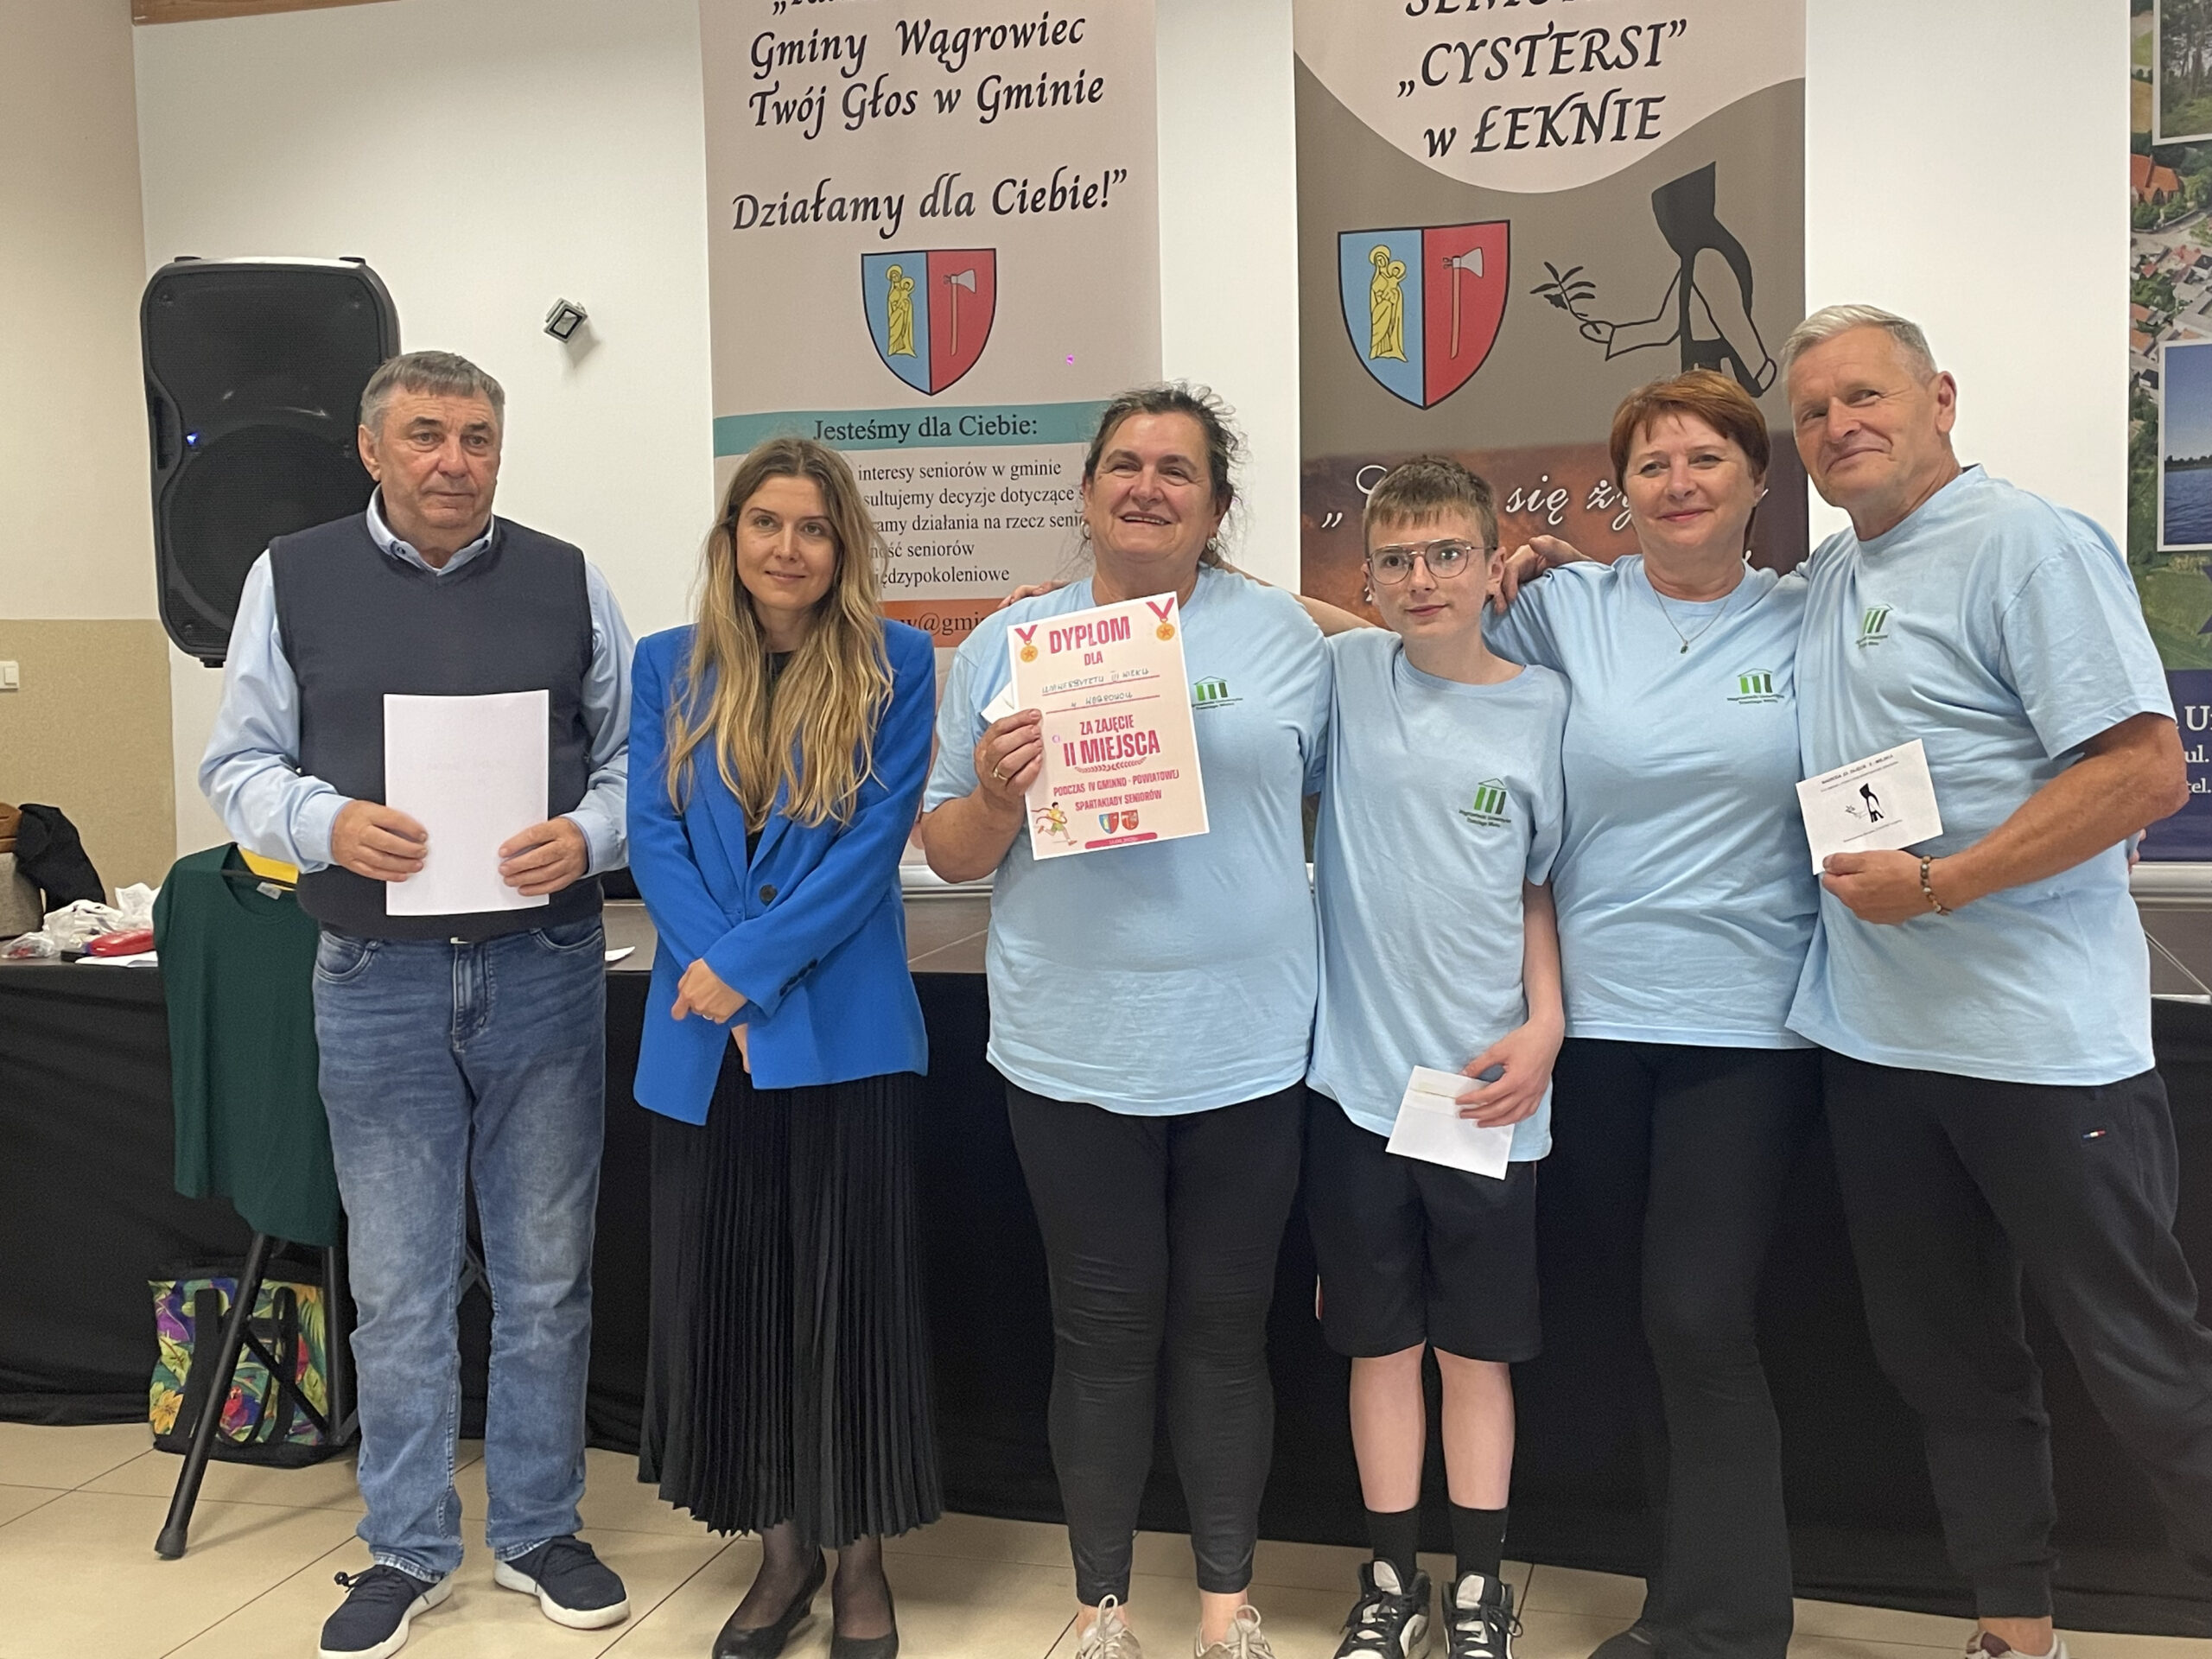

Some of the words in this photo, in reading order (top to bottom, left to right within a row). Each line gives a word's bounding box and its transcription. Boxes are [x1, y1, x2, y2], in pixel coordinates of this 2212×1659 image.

[751, 29, 868, 79] Gminy
[896, 11, 1085, 73] Wągrowiec
[749, 80, 825, 140] Twój
[842, 73, 918, 130] Głos
[933, 87, 961, 113] w
[977, 69, 1104, 124] Gminie
[1424, 126, 1457, 157] w
[1471, 88, 1666, 154] ŁEKNIE
[733, 178, 905, 239] Działamy
[918, 173, 976, 218] dla
[992, 166, 1127, 215] Ciebie!”
[813, 420, 911, 443] Jesteśmy
[918, 416, 950, 436] dla
[959, 414, 1037, 436] Ciebie:
[858, 465, 914, 483] interesy
[919, 461, 988, 479] seniorów
[991, 465, 1005, 476] w
[1010, 458, 1061, 480] gminie
[864, 490, 934, 510] sultujemy
[939, 486, 995, 507] decyzje
[1001, 486, 1074, 506] dotyczące
[1505, 475, 1569, 525] się
[912, 514, 979, 531] działania
[984, 518, 1001, 529] na
[1006, 517, 1045, 529] rzecz
[907, 540, 975, 558] seniorów
[874, 566, 1009, 588] iędzypokoleniowe
[1049, 616, 1131, 654] DYPLOM
[1084, 651, 1103, 666] DLA
[1080, 721, 1093, 735] ZA
[1095, 715, 1134, 733] ZAJĘCIE
[1063, 742, 1077, 766] II
[1080, 730, 1160, 764] MIEJSCA
[2184, 744, 2209, 763] ul.
[1053, 784, 1085, 797] PODCZAS
[1088, 782, 1096, 792] IV
[1132, 769, 1179, 785] POWIATOWEJ
[1075, 796, 1122, 811] SPARTAKIADY
[1124, 789, 1162, 804] SENIORÓW
